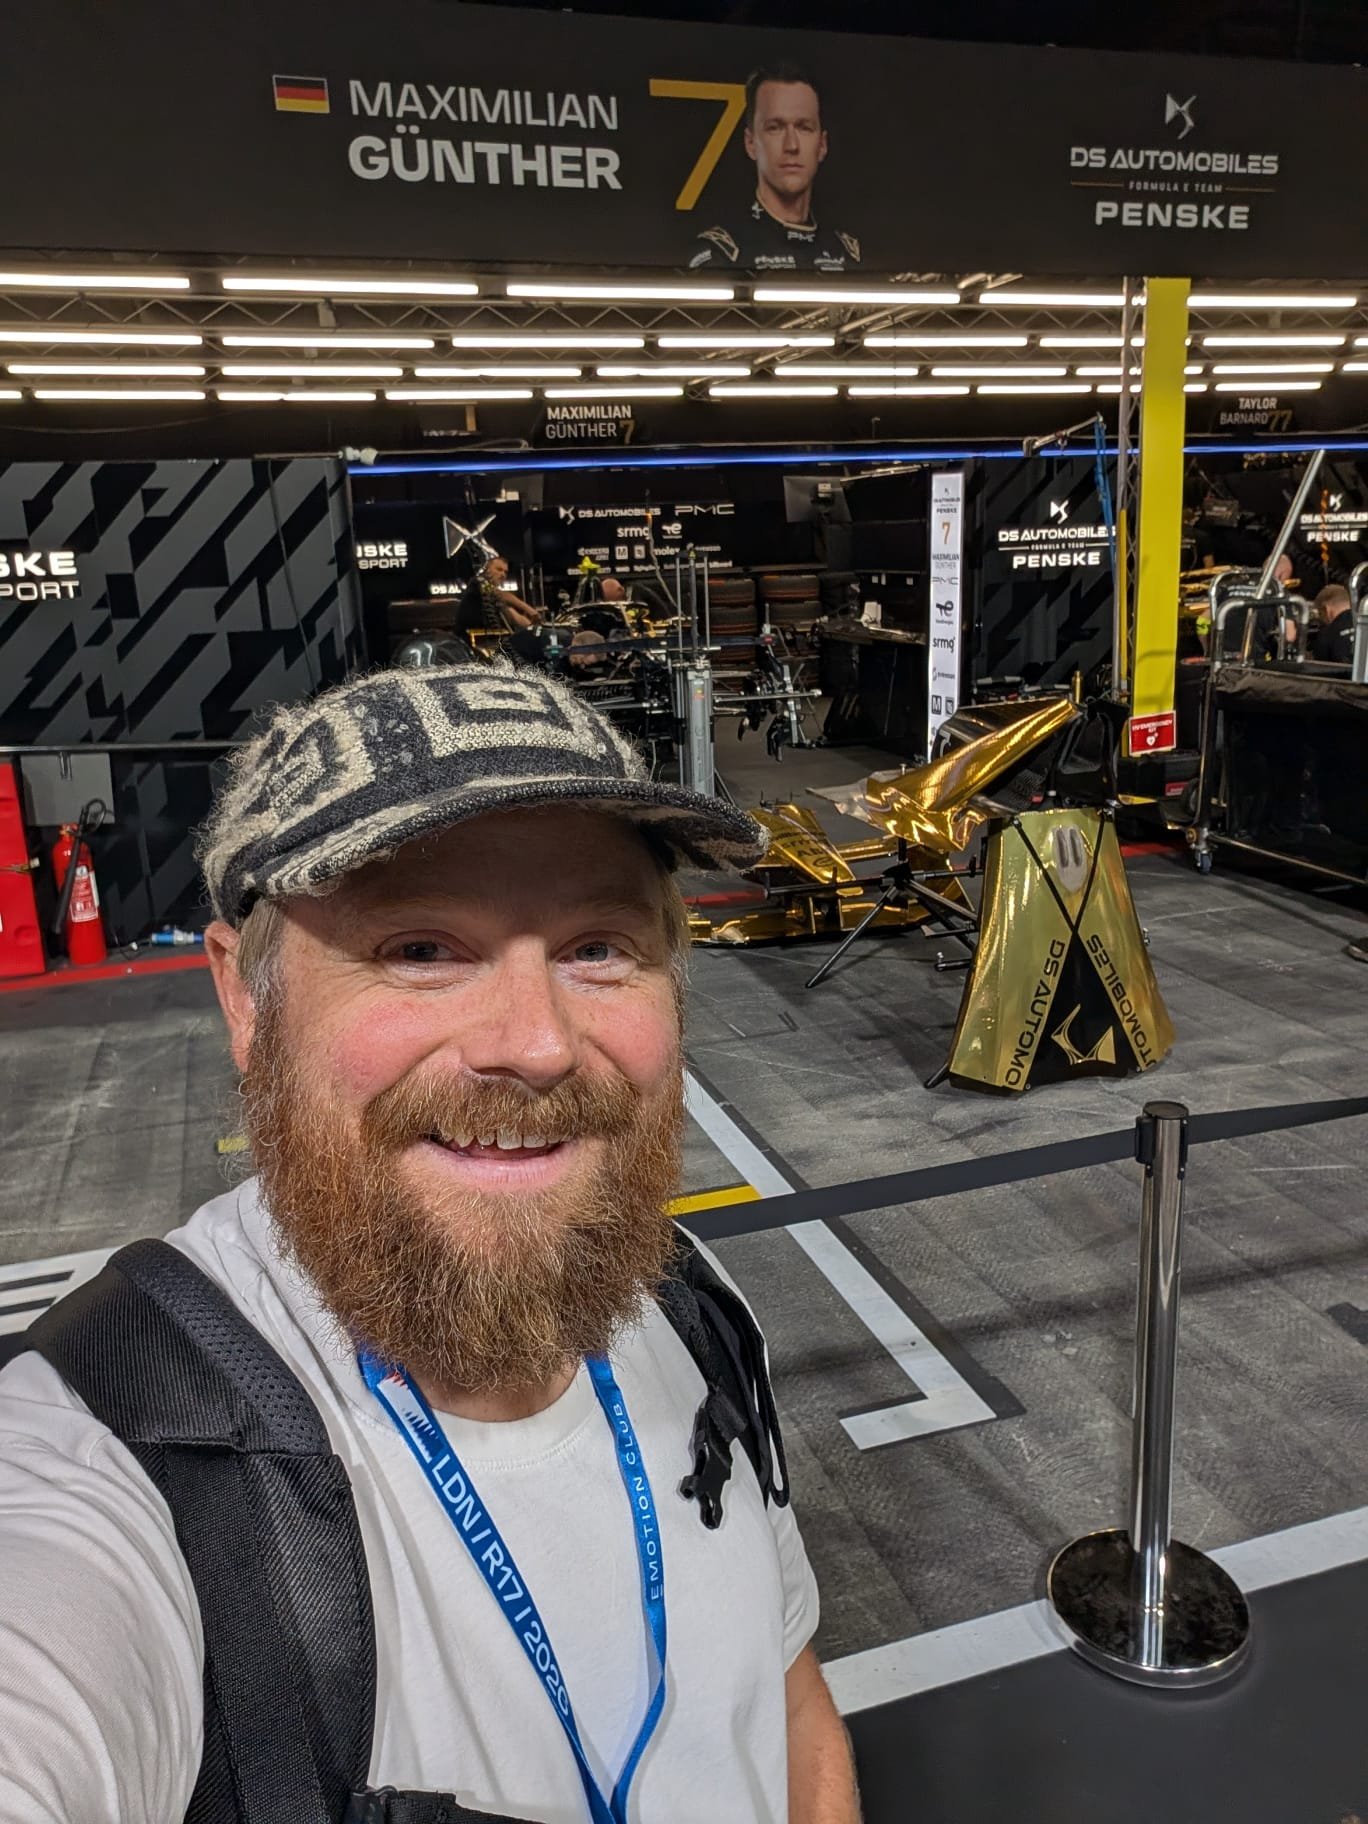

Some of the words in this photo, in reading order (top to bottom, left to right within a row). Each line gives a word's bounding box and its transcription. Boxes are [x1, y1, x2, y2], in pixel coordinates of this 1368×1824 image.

[349, 79, 618, 130] MAXIMILIAN
[650, 78, 747, 211] 7
[348, 124, 623, 190] GÜNTHER
[1070, 147, 1106, 168] DS
[1109, 149, 1279, 174] AUTOMOBILES
[1129, 181, 1179, 192] FORMULA
[1195, 183, 1223, 193] TEAM
[1095, 201, 1250, 229] PENSKE
[546, 405, 632, 420] MAXIMILIAN
[1238, 397, 1277, 410] TAYLOR
[545, 421, 617, 439] GÜNTHER
[619, 419, 635, 444] 7
[1220, 411, 1269, 425] BARNARD
[1268, 409, 1292, 432] 77
[675, 504, 735, 516] PMC
[942, 521, 951, 545] 7
[998, 530, 1019, 542] DS
[1307, 530, 1359, 543] PENSKE
[1012, 551, 1101, 569] PENSKE
[932, 637, 955, 653] srmg
[1044, 939, 1065, 977] DS
[613, 1403, 636, 1465] CLUB
[432, 1454, 482, 1532] LDN
[481, 1540, 524, 1602] R17
[633, 1476, 663, 1600] EMOTION
